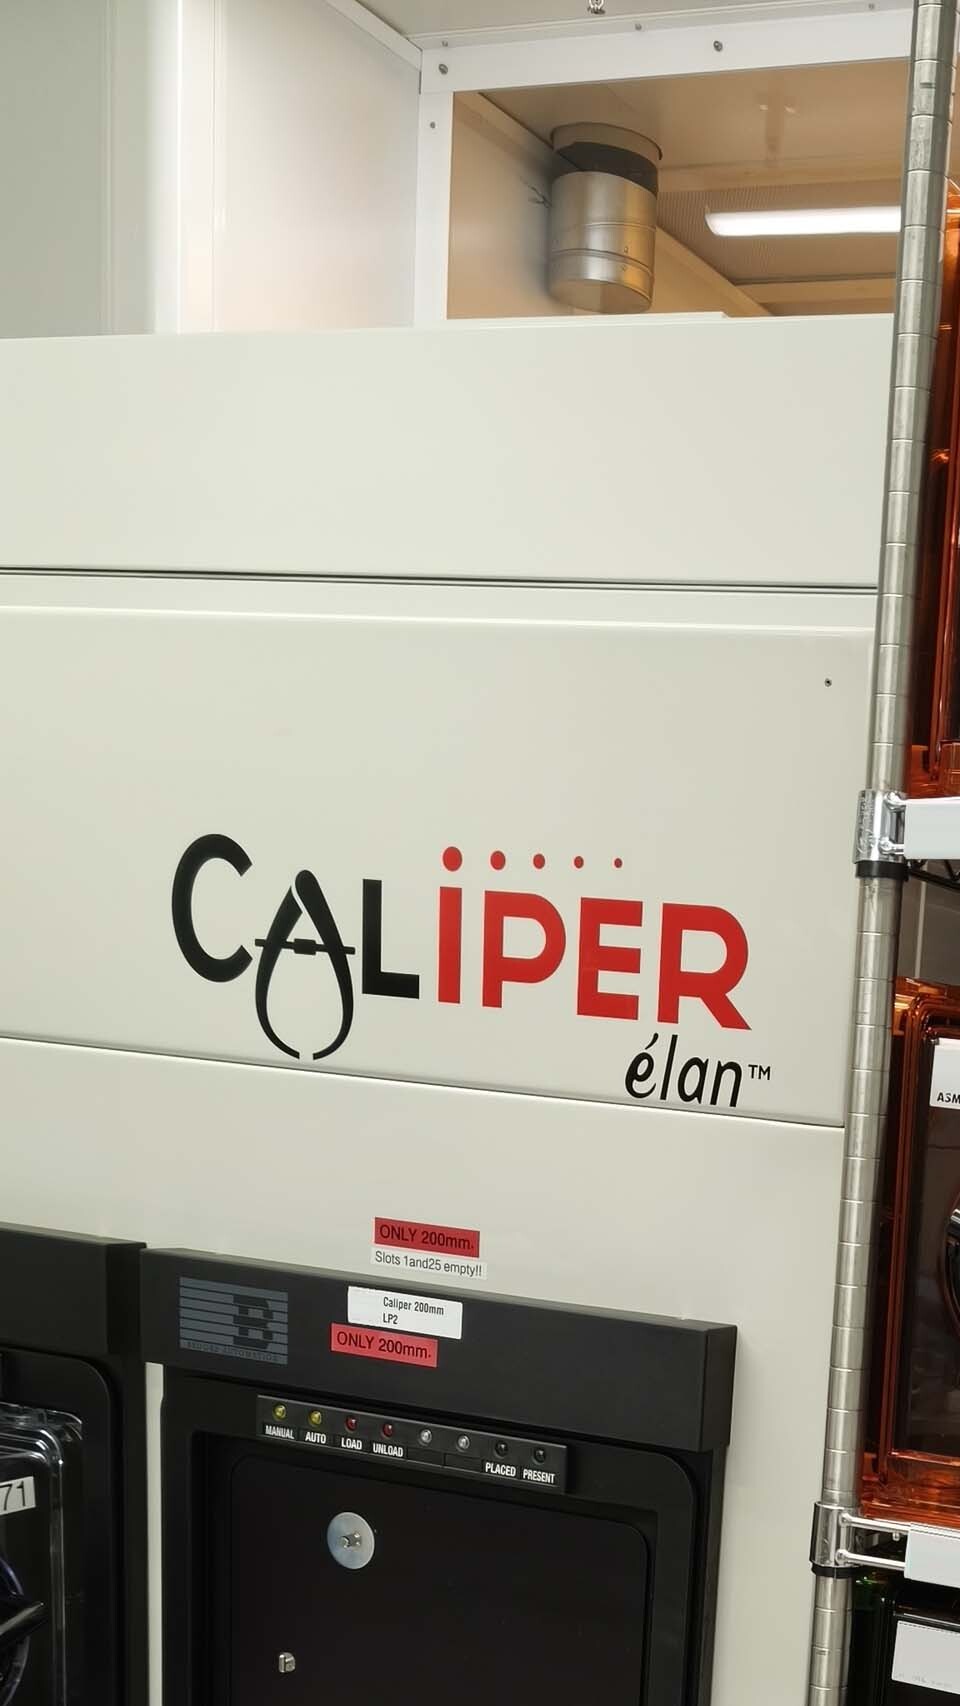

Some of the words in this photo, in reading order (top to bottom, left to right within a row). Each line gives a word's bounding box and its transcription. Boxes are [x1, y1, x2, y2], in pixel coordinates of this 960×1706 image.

[379, 1224, 417, 1242] ONLY
[421, 1230, 474, 1250] 200mm.
[375, 1250, 400, 1265] Slots
[404, 1255, 441, 1271] 1and25
[443, 1261, 482, 1277] empty!!
[382, 1313, 398, 1324] LP2
[383, 1296, 412, 1310] Caliper
[414, 1301, 444, 1315] 200mm
[337, 1331, 375, 1350] ONLY
[378, 1338, 431, 1359] 200mm.
[265, 1425, 295, 1439] MANUAL
[305, 1431, 327, 1444] AUTO
[341, 1437, 363, 1450] LOAD
[372, 1443, 404, 1457] UNLOAD
[485, 1461, 517, 1477] PLACED
[522, 1468, 556, 1484] PRESENT
